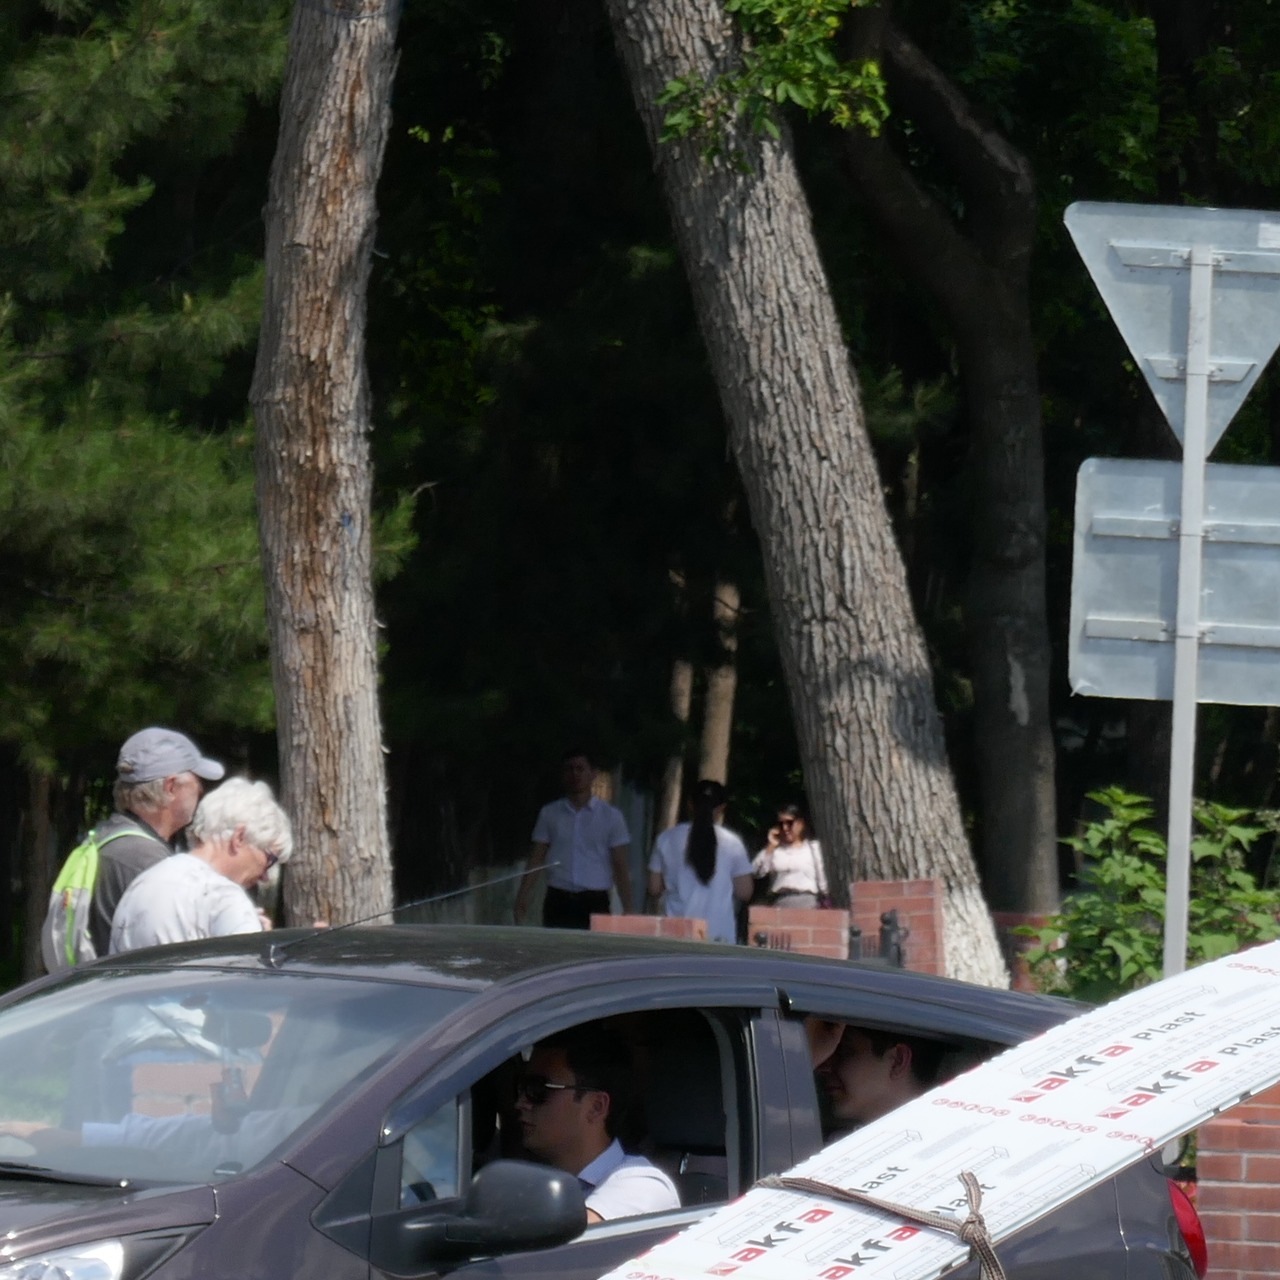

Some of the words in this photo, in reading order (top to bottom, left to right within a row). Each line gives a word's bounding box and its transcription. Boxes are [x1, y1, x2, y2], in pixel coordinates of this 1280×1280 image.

[1033, 1044, 1134, 1091] akfa
[1131, 1009, 1206, 1041] Plast
[1119, 1060, 1220, 1107] akfa
[730, 1208, 834, 1263] akfa
[848, 1165, 910, 1194] last
[817, 1224, 922, 1280] akfa
